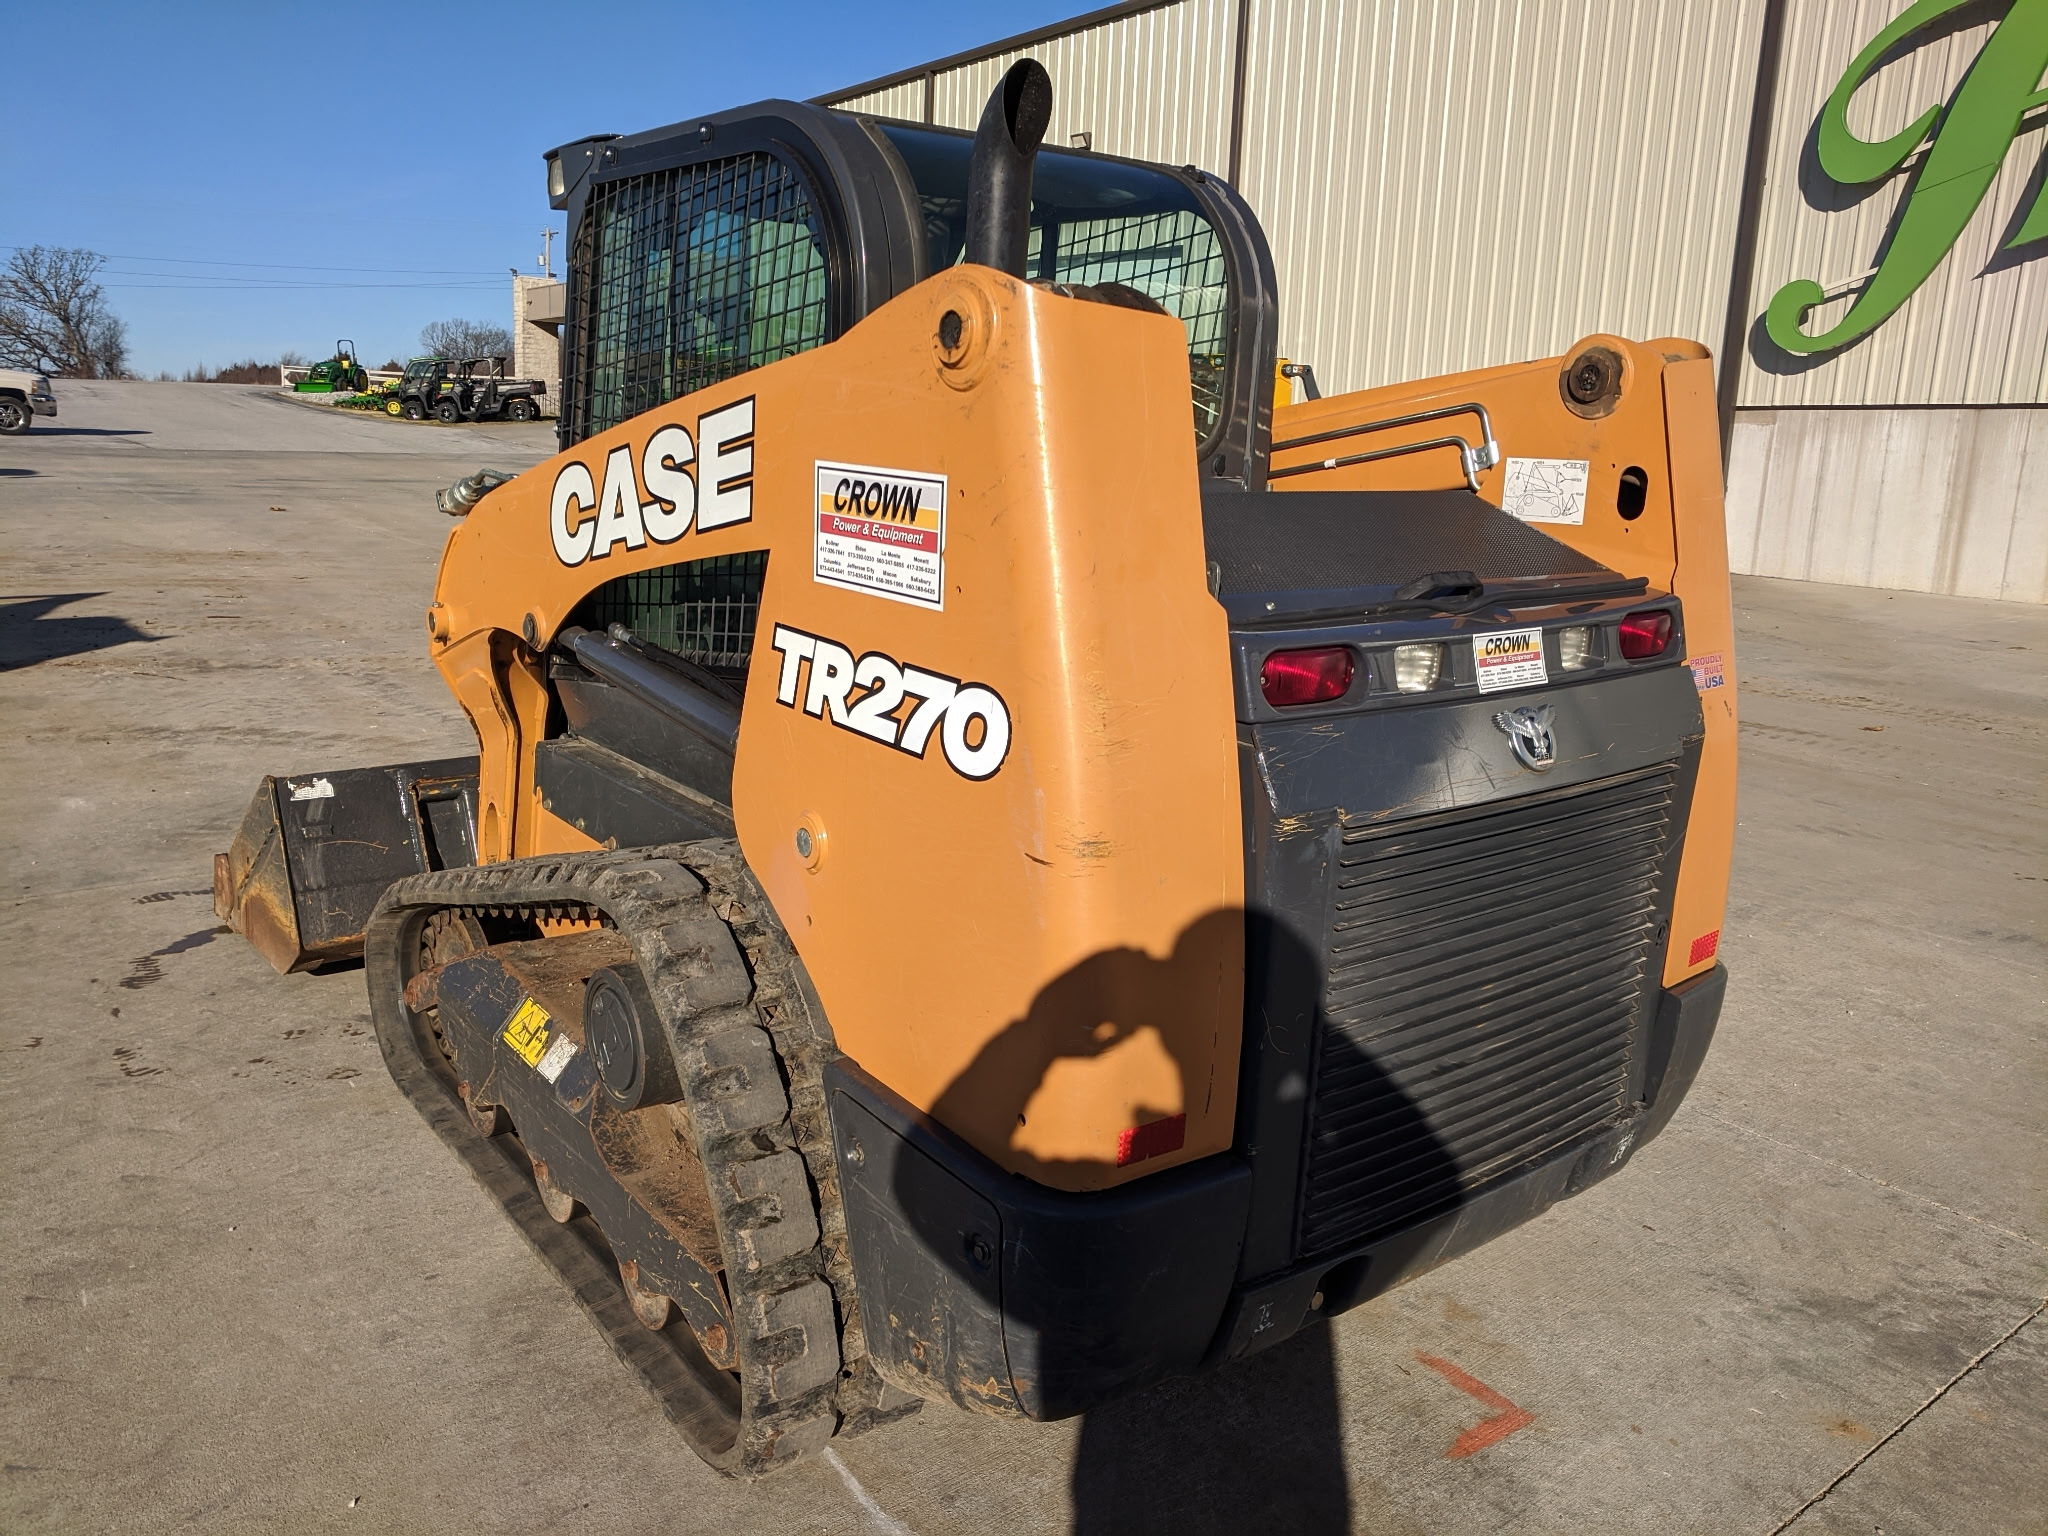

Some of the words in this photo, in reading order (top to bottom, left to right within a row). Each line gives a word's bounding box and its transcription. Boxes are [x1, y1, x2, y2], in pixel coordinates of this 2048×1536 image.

[550, 394, 756, 568] CASE
[834, 477, 922, 523] CROWN
[833, 517, 861, 534] Power
[862, 523, 870, 536] &
[872, 524, 924, 545] Equipment
[1485, 634, 1530, 656] CROWN
[1486, 656, 1502, 665] Power
[1690, 655, 1723, 666] PROUDLY
[1704, 664, 1724, 675] BUILT
[1705, 675, 1724, 688] USA
[772, 622, 1012, 782] TR270
